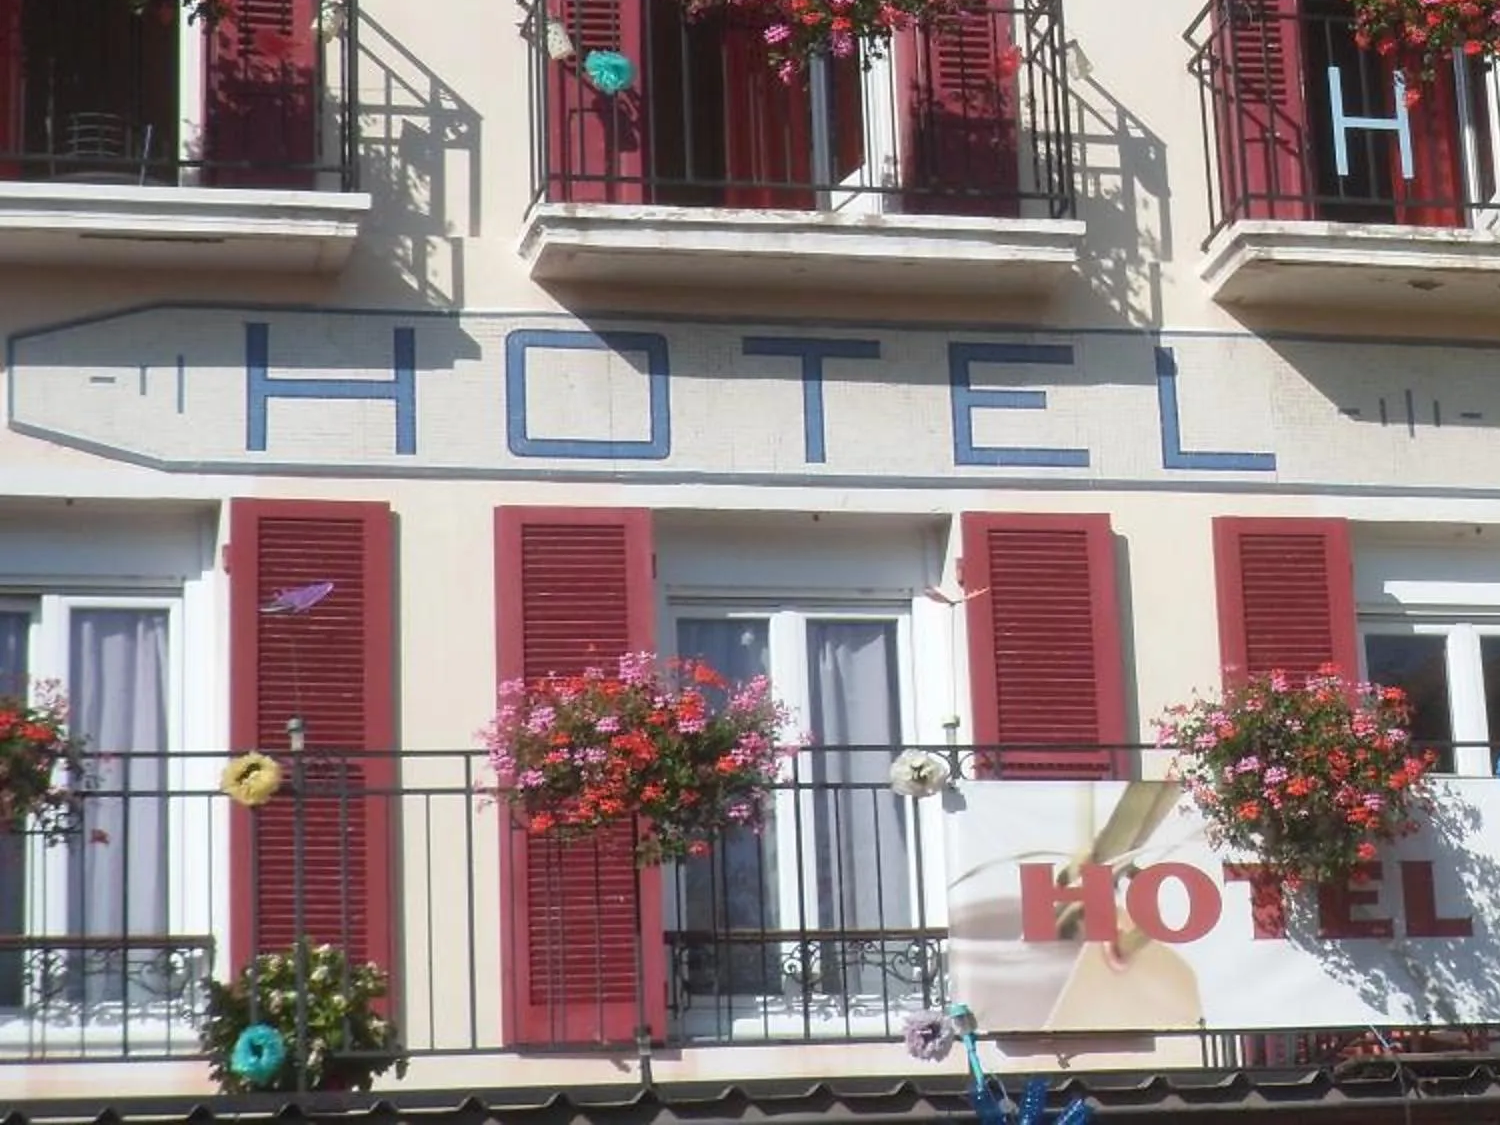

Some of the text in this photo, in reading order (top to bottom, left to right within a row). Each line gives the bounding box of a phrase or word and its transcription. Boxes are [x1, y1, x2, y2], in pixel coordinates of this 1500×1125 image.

[1328, 66, 1414, 179] H
[245, 322, 1276, 470] HOTEL
[1019, 860, 1474, 943] HOTEL
